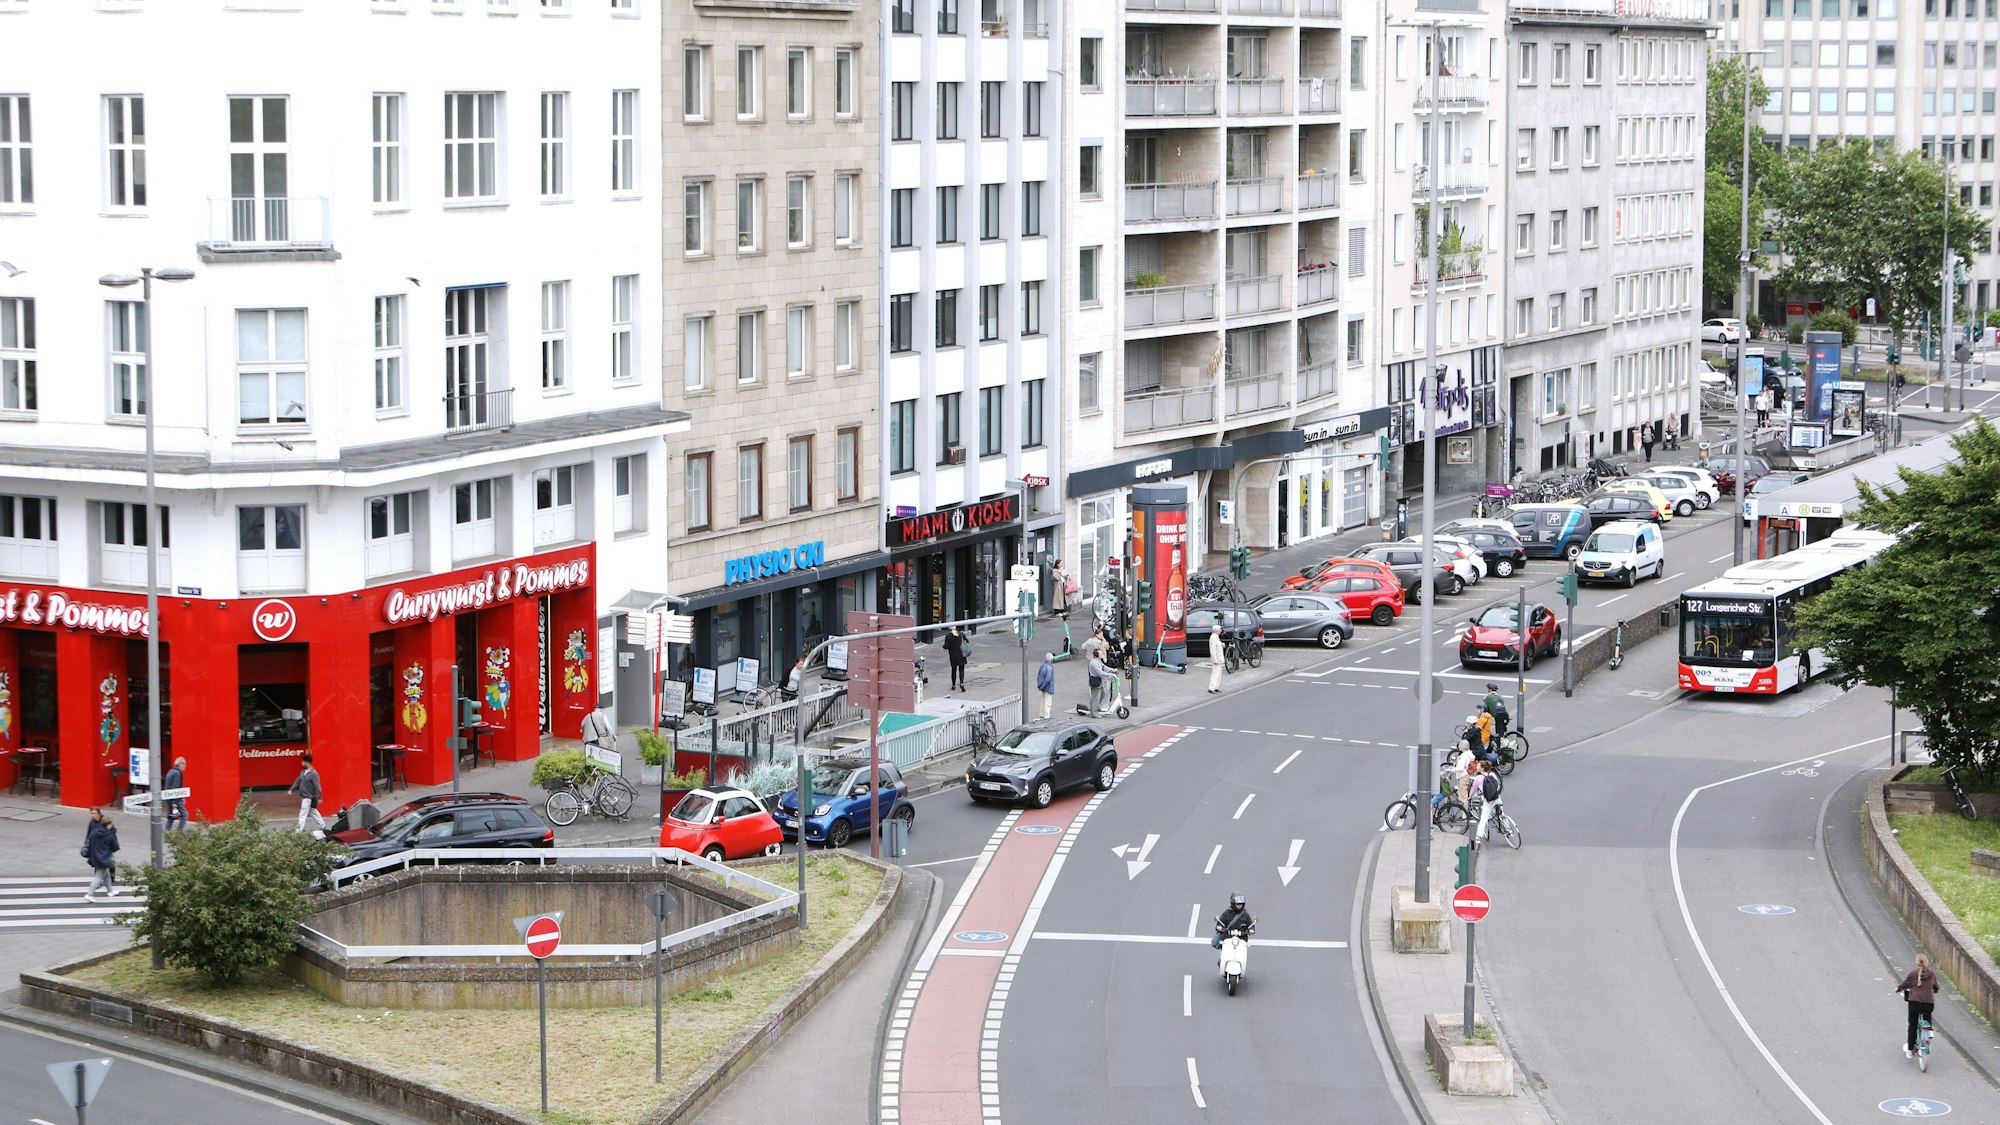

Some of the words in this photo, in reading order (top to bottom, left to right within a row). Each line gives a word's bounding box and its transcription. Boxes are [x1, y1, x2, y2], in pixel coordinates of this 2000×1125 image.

[1335, 425, 1350, 435] sun
[1350, 420, 1359, 431] in
[1304, 432, 1319, 443] sun
[1319, 428, 1328, 439] in
[1027, 476, 1047, 487] KIOSK
[1781, 506, 1789, 515] A
[902, 511, 949, 543] MIAMI
[968, 498, 1012, 529] KIOSK
[1156, 524, 1178, 534] DRINK
[1159, 534, 1178, 544] OHNE
[725, 547, 792, 586] PHYSIO
[1013, 569, 1025, 577] WC
[385, 571, 495, 623] Currywurst
[496, 567, 511, 601] &
[512, 558, 589, 597] Pommes
[22, 590, 43, 624] &
[1686, 600, 1703, 612] 127
[1705, 600, 1748, 613] Longericher
[1748, 602, 1763, 614] Str.
[739, 658, 745, 673] 1
[695, 668, 701, 683] 1
[126, 794, 150, 805] Ebertplatz
[164, 789, 188, 799] Ebertplatz
